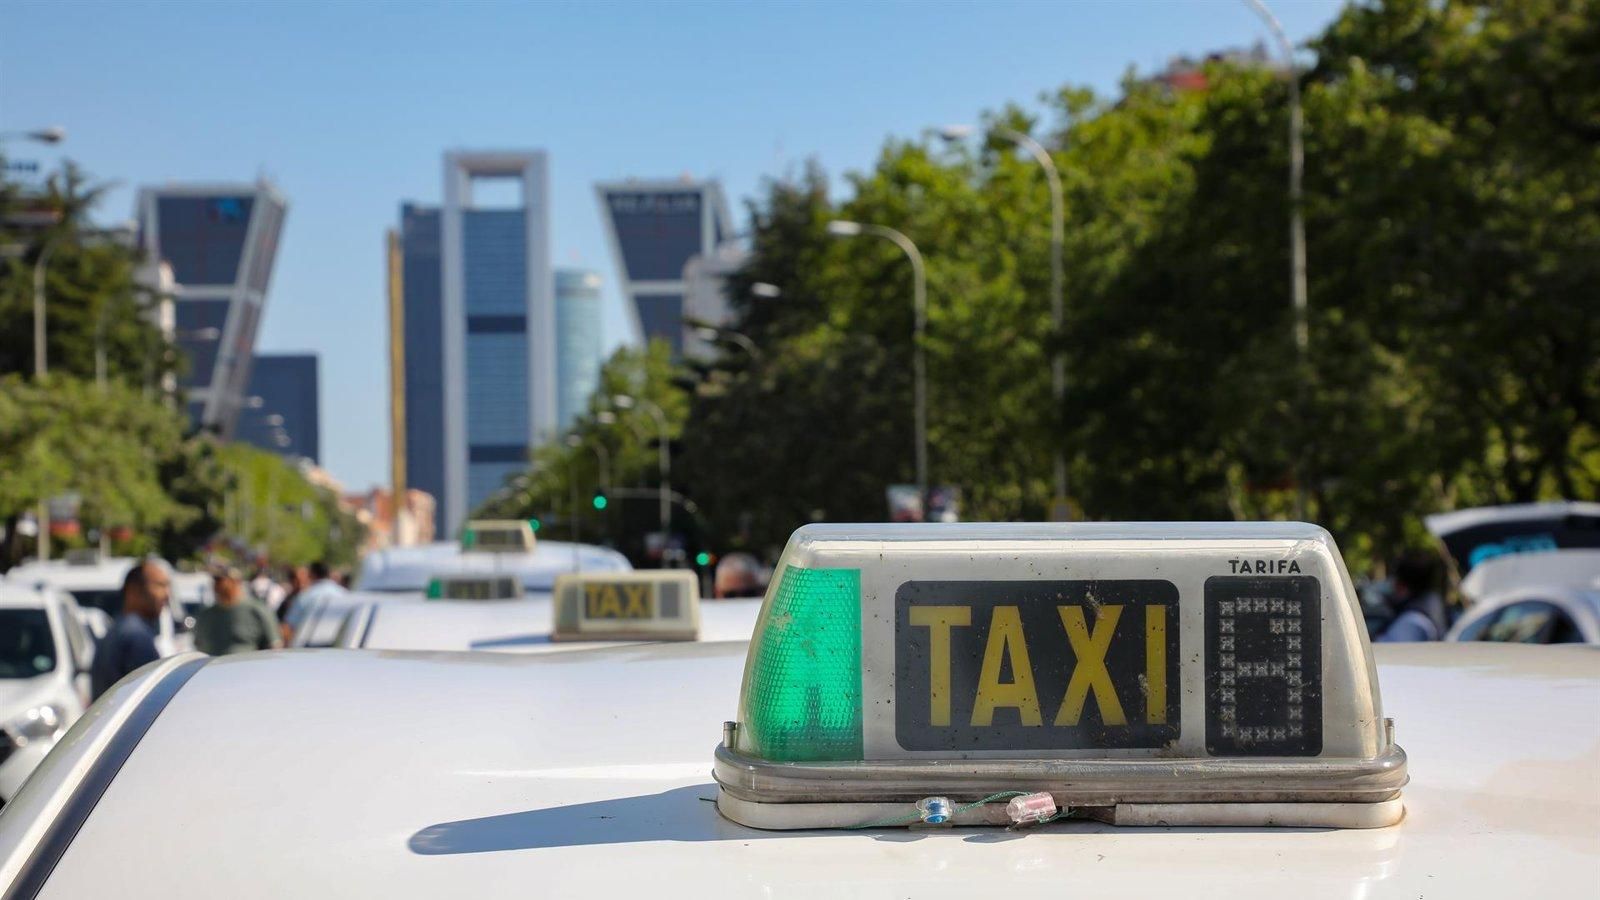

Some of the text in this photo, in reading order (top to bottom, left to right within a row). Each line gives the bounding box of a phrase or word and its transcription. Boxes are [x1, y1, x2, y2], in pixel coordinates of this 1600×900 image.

[1228, 559, 1301, 574] TARIFA
[584, 582, 656, 619] TAXI
[908, 604, 1167, 727] TAXI
